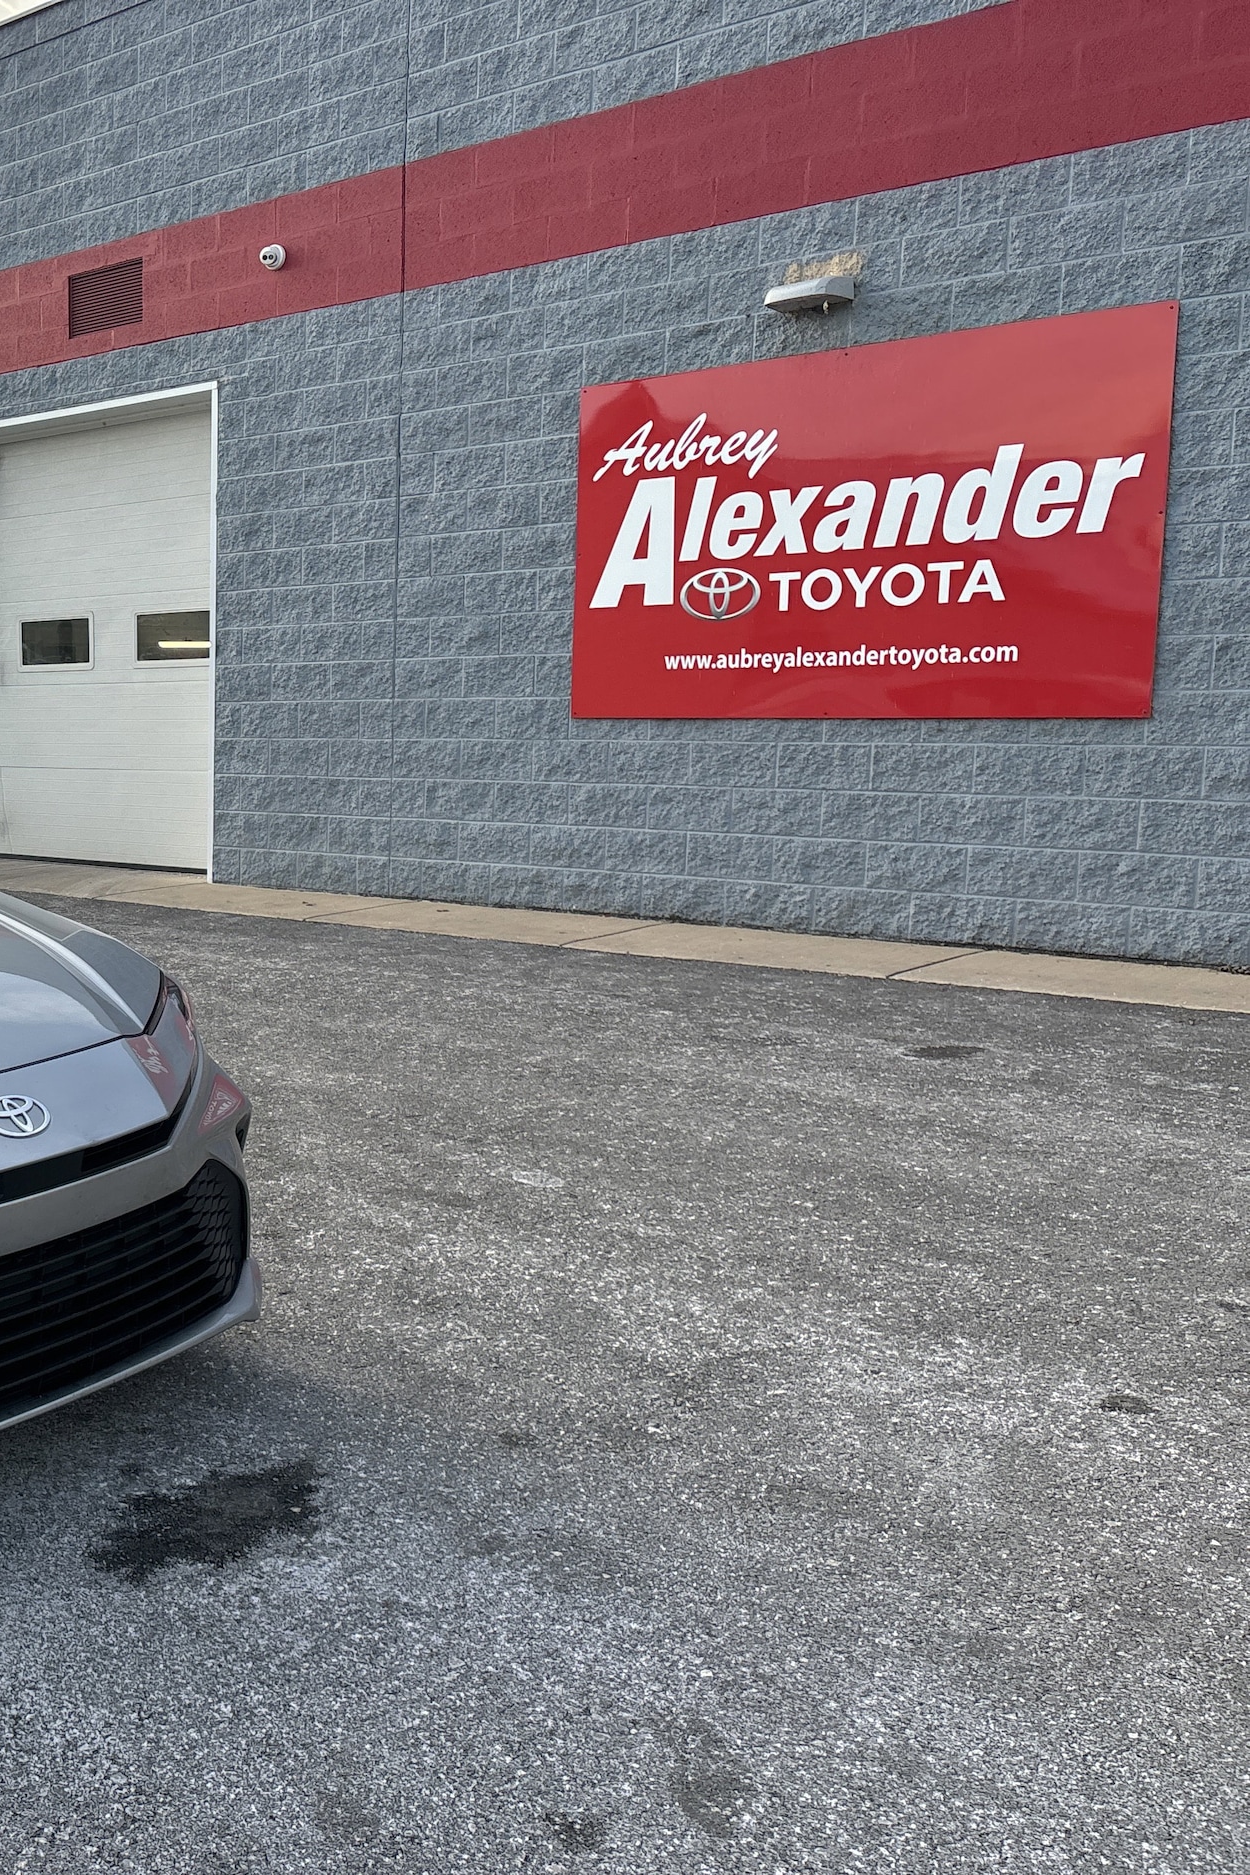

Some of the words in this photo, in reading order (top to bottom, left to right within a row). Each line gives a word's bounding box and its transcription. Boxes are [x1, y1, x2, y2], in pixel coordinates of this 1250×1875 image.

[592, 412, 778, 482] Aubrey
[589, 443, 1146, 609] Alexander
[768, 559, 1006, 612] TOYOTA
[664, 644, 1019, 673] www.aubreyalexandertoyota.com
